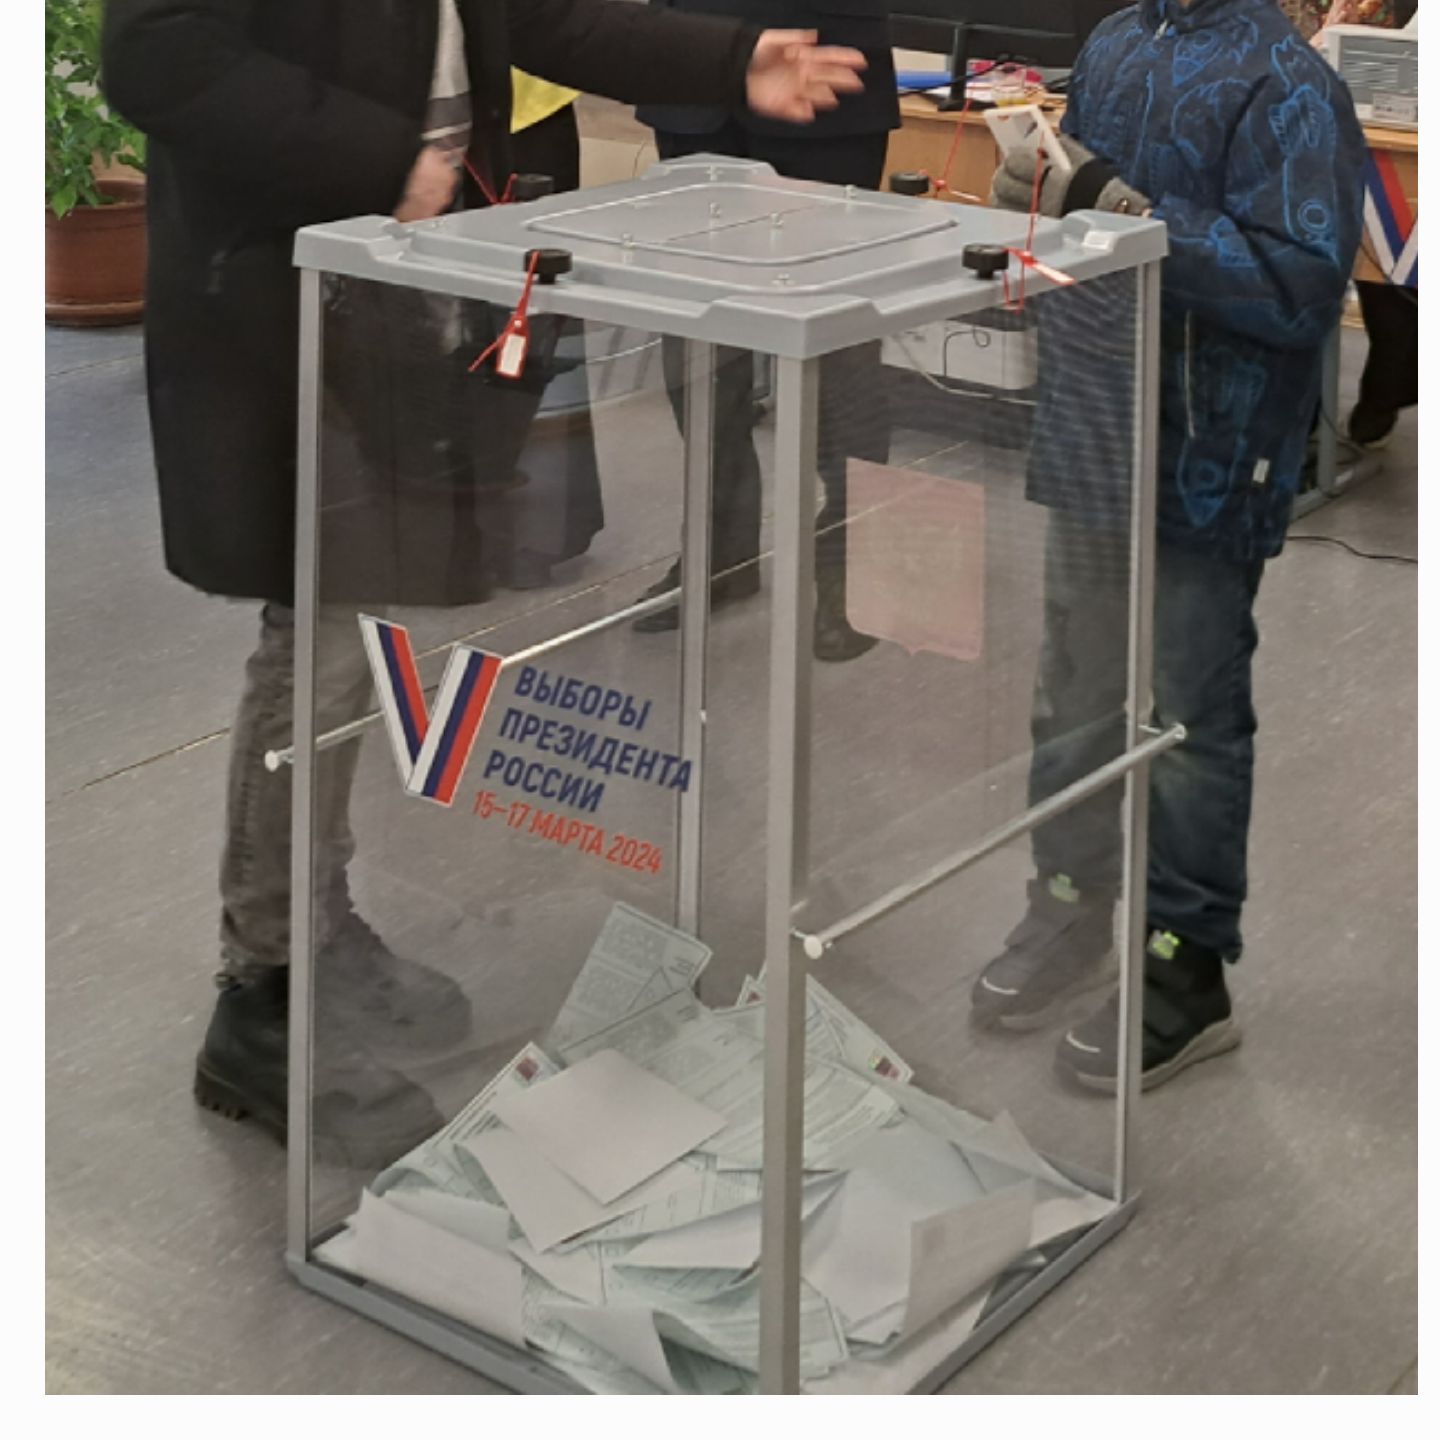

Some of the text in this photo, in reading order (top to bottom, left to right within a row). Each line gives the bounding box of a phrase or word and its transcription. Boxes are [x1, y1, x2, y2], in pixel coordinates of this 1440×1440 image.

[514, 666, 652, 730] ВЫБОРЫ
[483, 750, 605, 812] РОССИИ
[499, 708, 692, 793] ПРЕЗИДЕНТА
[528, 812, 603, 856] МАРТА
[605, 834, 663, 874] 2024
